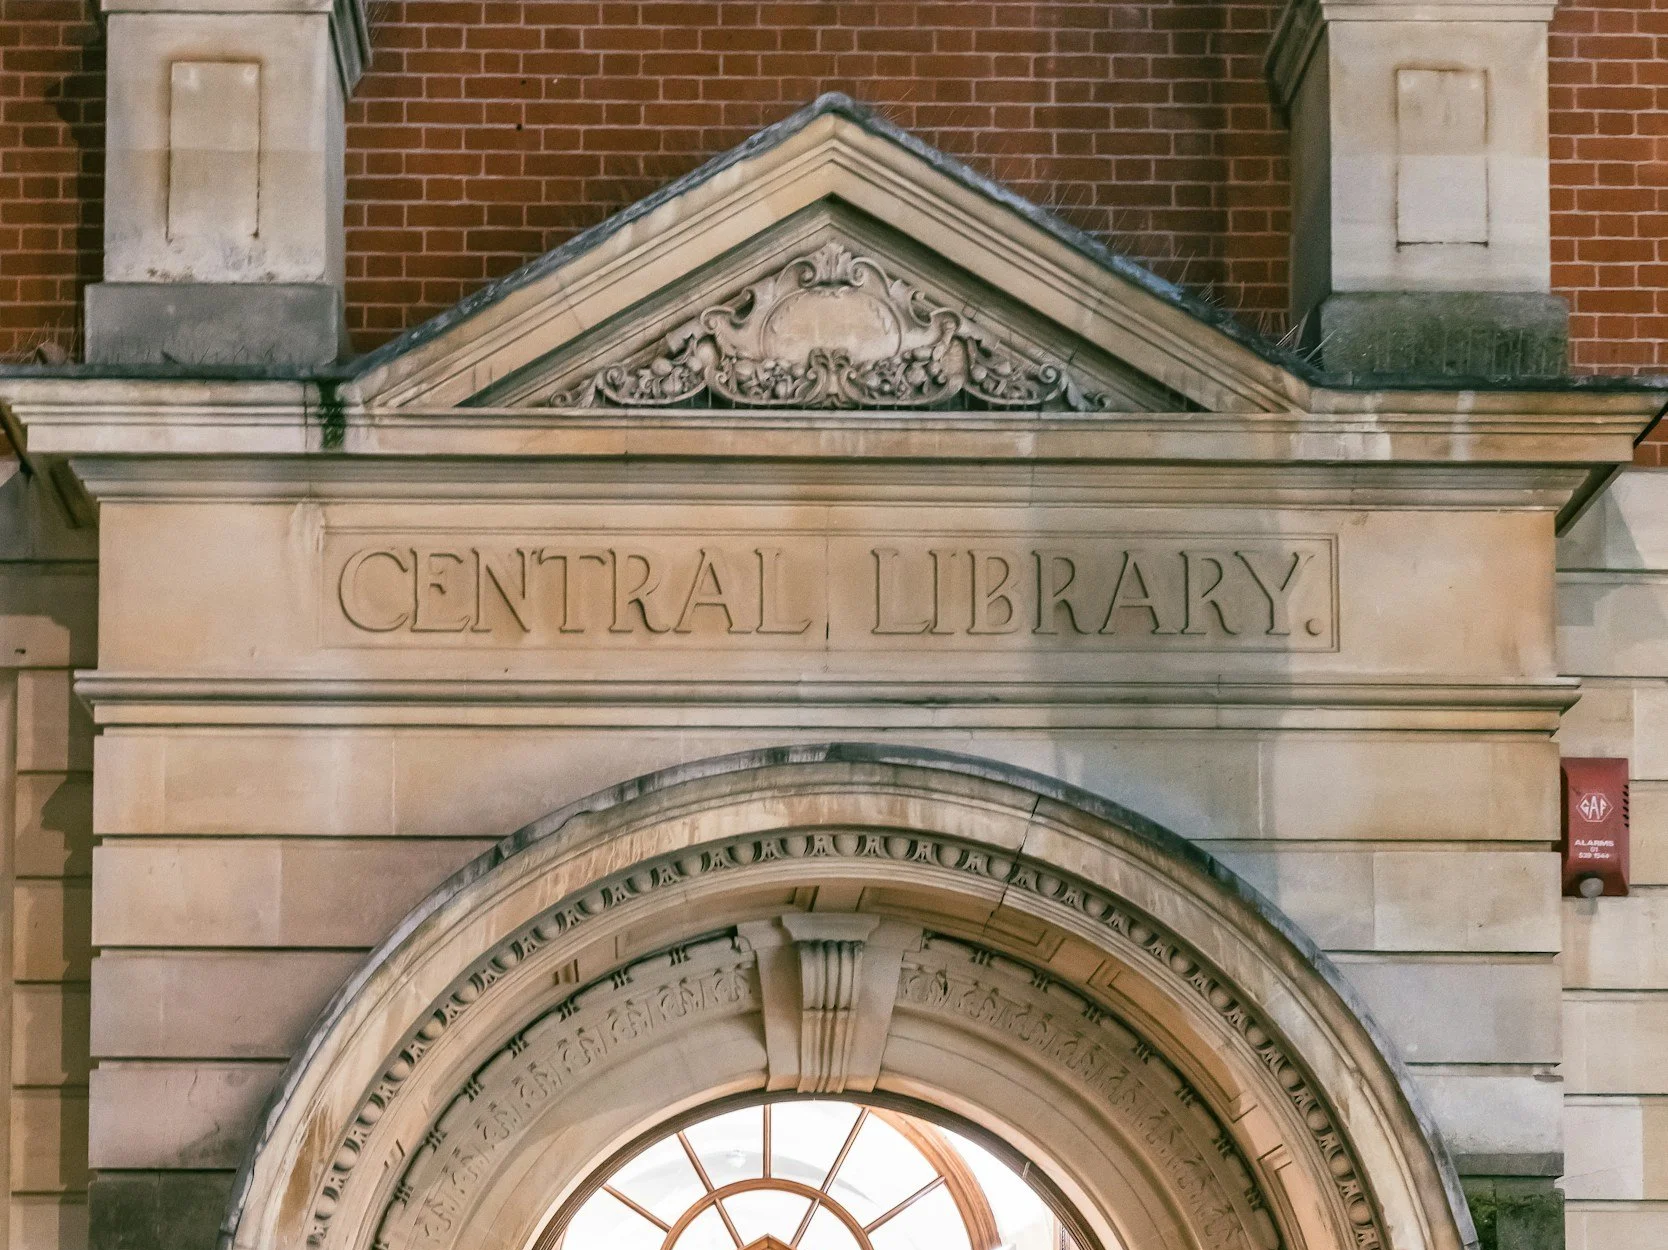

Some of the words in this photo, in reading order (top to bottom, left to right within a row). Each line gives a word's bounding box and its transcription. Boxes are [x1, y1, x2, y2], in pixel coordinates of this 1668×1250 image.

[337, 546, 813, 635] CENTRAL
[870, 546, 1322, 636] LIBRARY.
[1579, 795, 1608, 820] GAF
